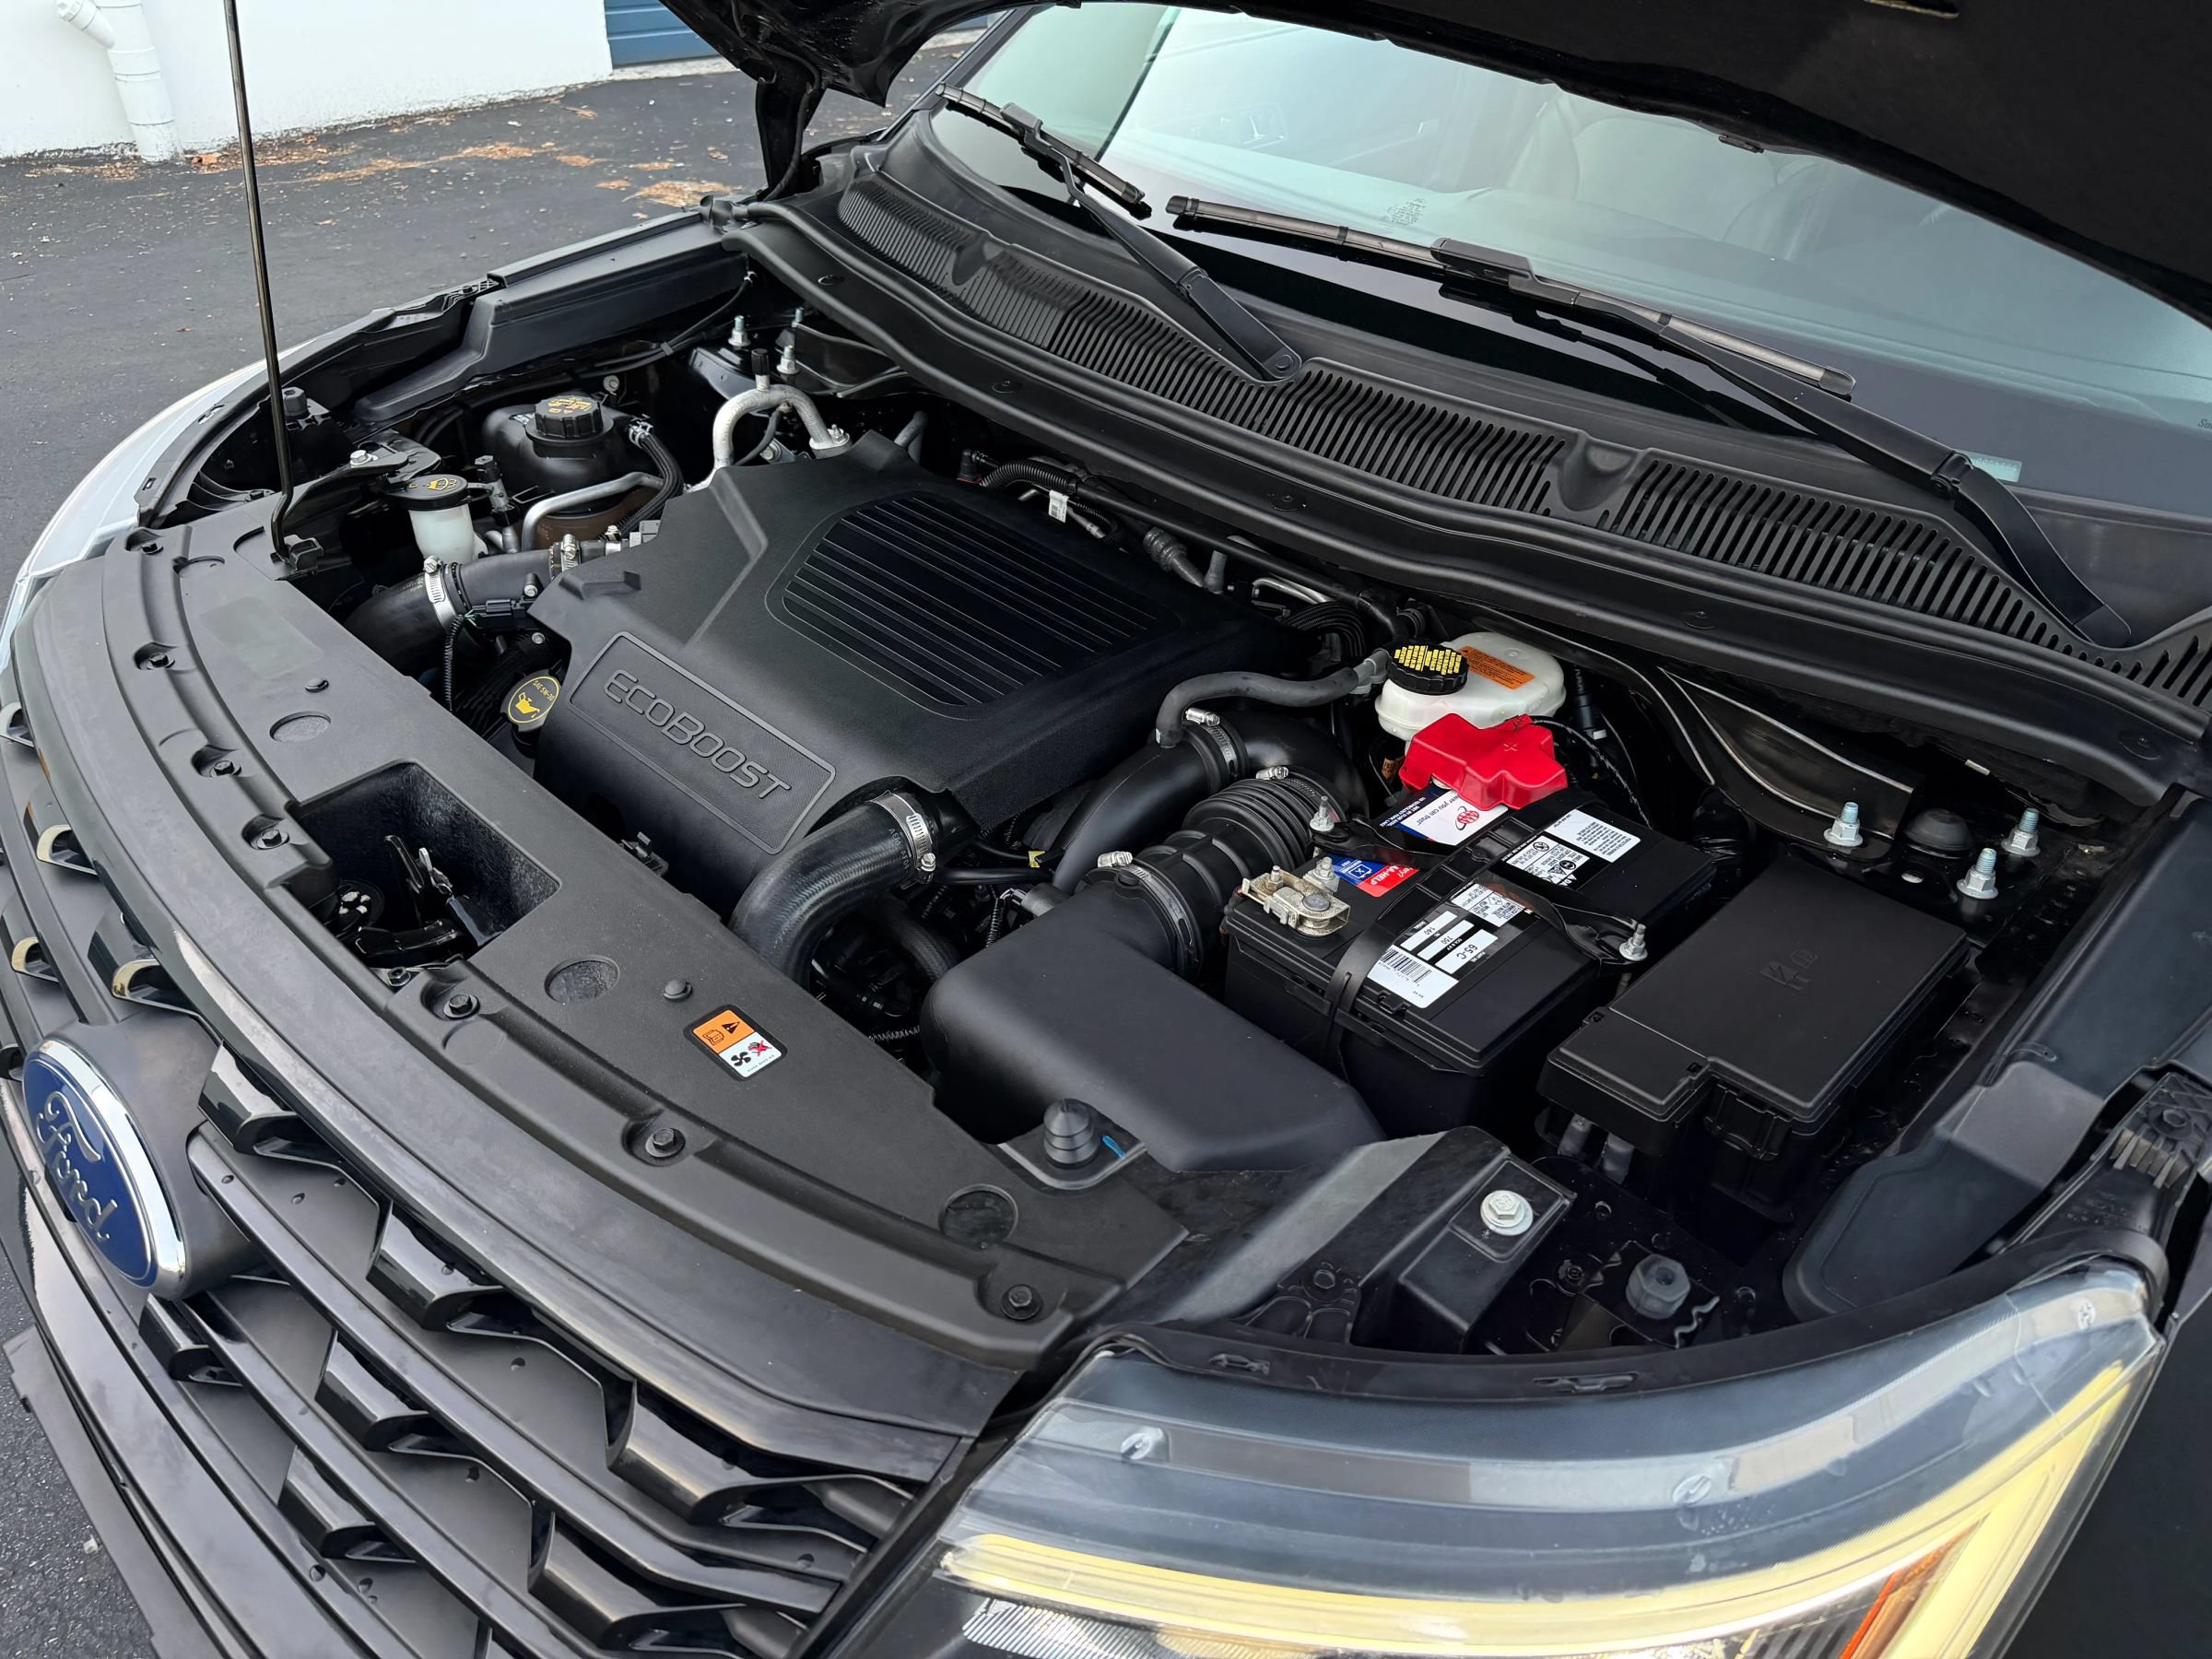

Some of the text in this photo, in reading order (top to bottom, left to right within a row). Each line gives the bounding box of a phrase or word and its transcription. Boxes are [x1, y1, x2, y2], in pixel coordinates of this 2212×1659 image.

[604, 669, 792, 799] ECOBOOST
[1424, 926, 1436, 935] 140
[1456, 944, 1478, 960] 65-C
[36, 1090, 118, 1241] Ford
